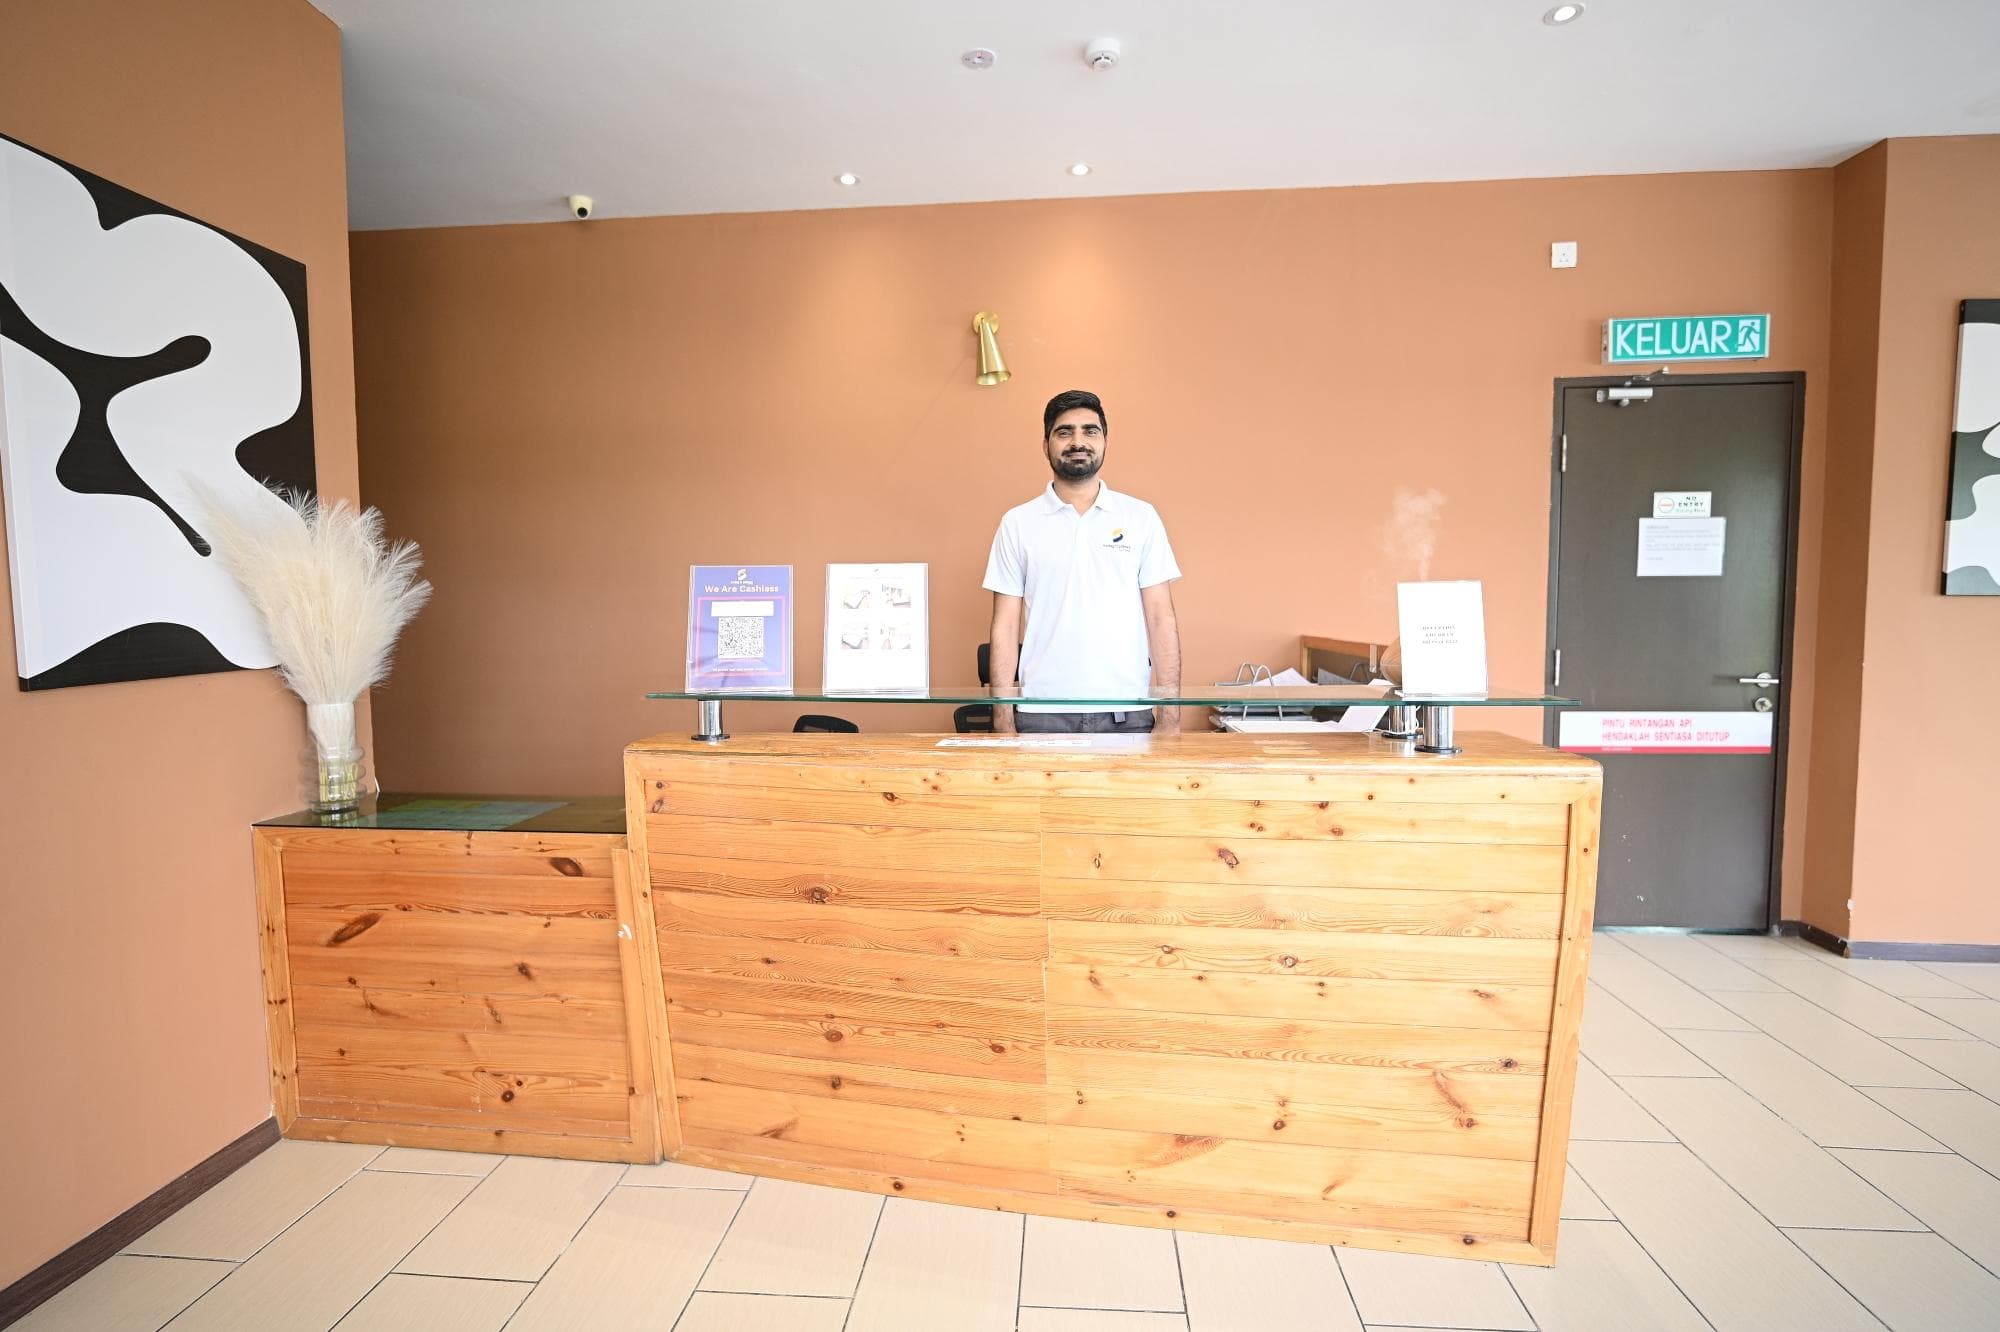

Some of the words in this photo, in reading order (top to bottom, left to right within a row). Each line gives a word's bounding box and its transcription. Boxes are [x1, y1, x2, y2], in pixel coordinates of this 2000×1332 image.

[1616, 320, 1732, 356] KELUAR
[704, 585, 720, 593] We
[721, 585, 738, 593] Are
[739, 584, 779, 593] Cashless
[1602, 719, 1625, 728] PINTU
[1629, 719, 1675, 728] RINTANGAN
[1679, 718, 1693, 728] API
[1602, 732, 1649, 741] HENDAKLAH
[1654, 731, 1692, 741] SENTIASA
[1697, 731, 1731, 741] DITUTUP
